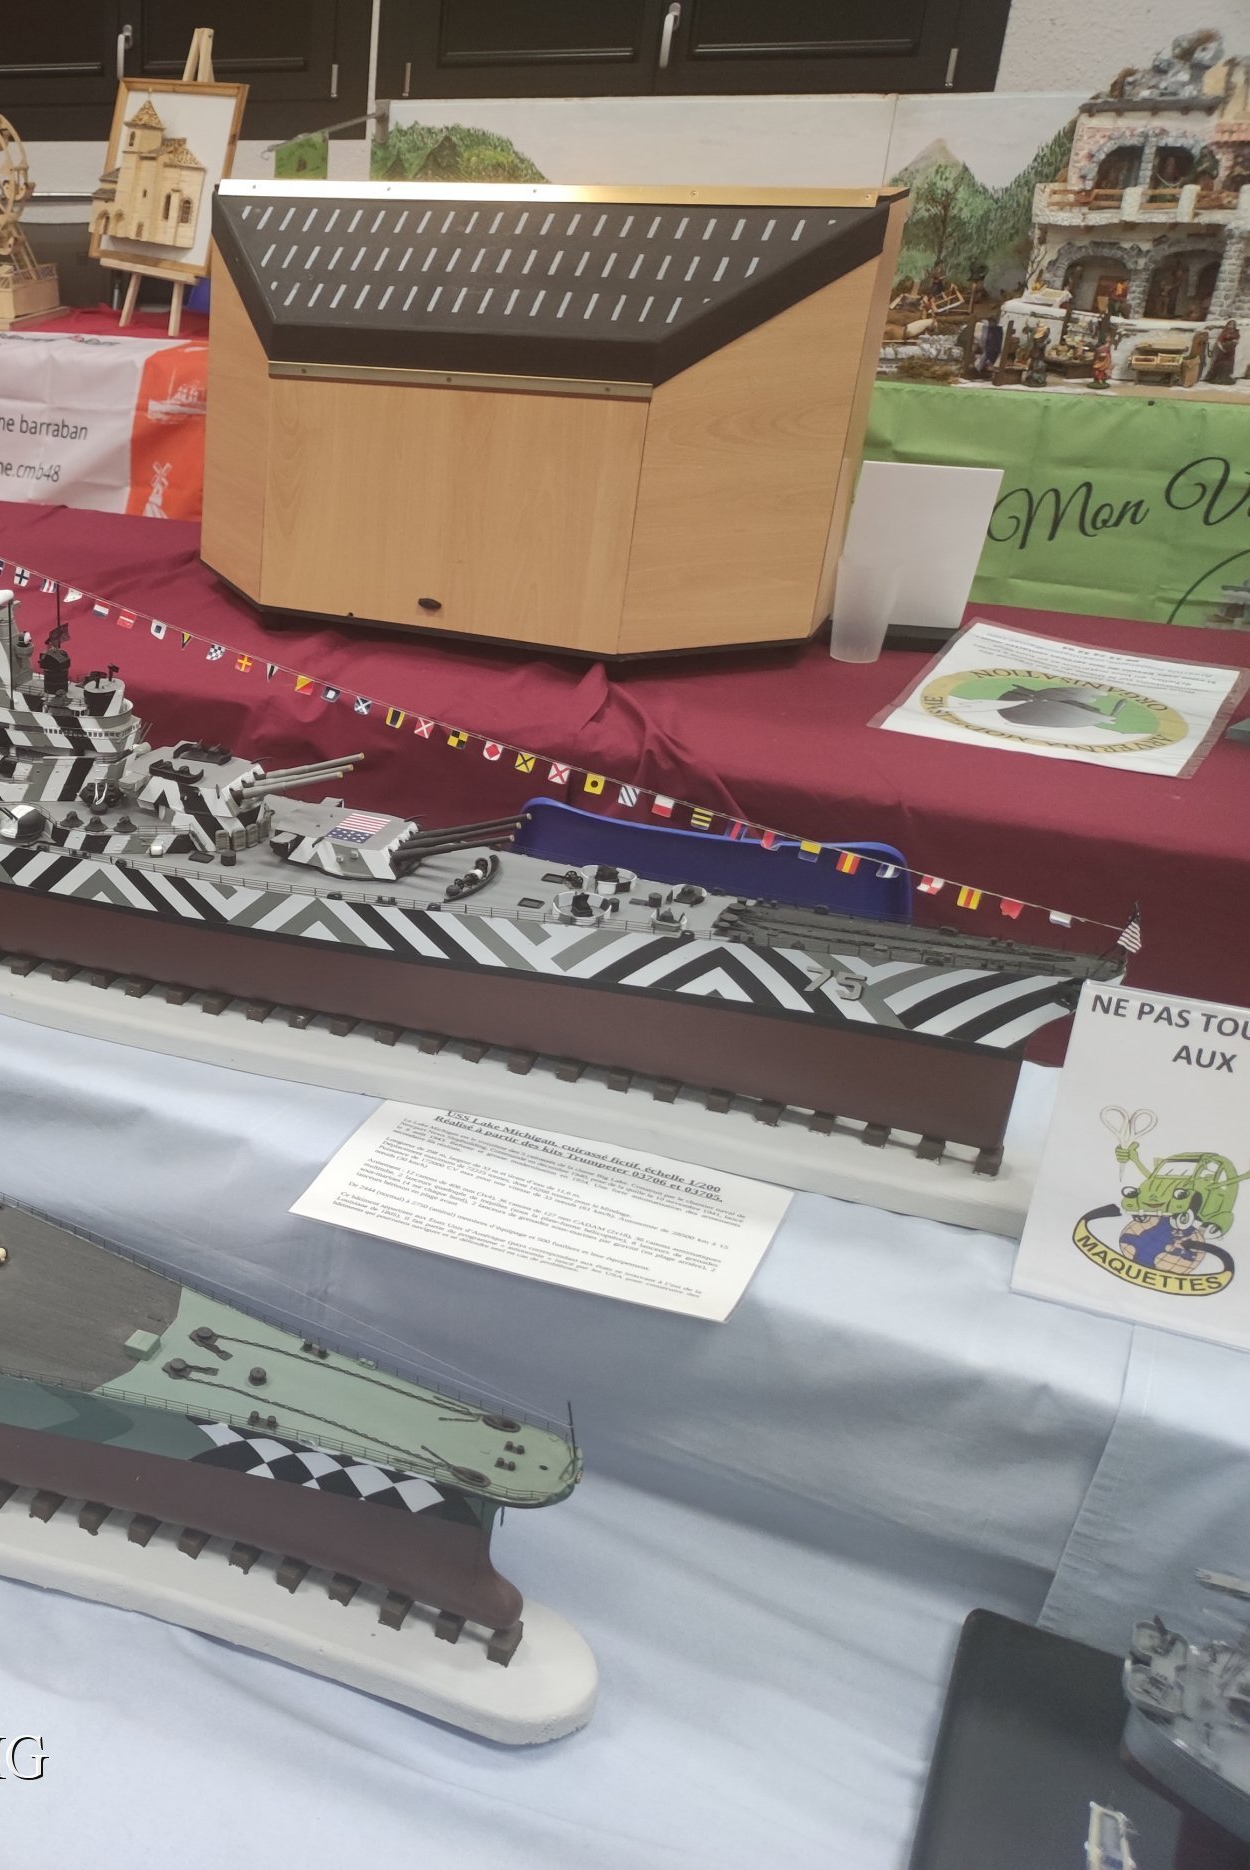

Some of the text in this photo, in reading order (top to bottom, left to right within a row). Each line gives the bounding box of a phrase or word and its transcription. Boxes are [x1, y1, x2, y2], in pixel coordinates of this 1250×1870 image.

[20, 414, 88, 441] barraban
[987, 481, 1149, 550] Mon
[972, 669, 1168, 712] ORGANISATION
[803, 966, 867, 1001] 75
[1091, 994, 1129, 1017] NE
[1137, 1002, 1191, 1028] PAS
[1172, 1045, 1237, 1073] AUX
[433, 1114, 476, 1131] Réalisé
[483, 1128, 520, 1144] partir
[519, 1139, 541, 1149] des
[540, 1145, 565, 1156] kits
[564, 1151, 631, 1176] Trumpeter
[630, 1170, 668, 1186] 03706
[668, 1181, 683, 1190] et
[470, 1117, 503, 1131] Lake
[500, 1125, 560, 1147] Michigan,
[560, 1142, 609, 1161] cuirassé
[642, 1165, 686, 1183] échelle
[687, 1178, 722, 1193] 1/200
[1077, 1233, 1223, 1293] MAQUETTES
